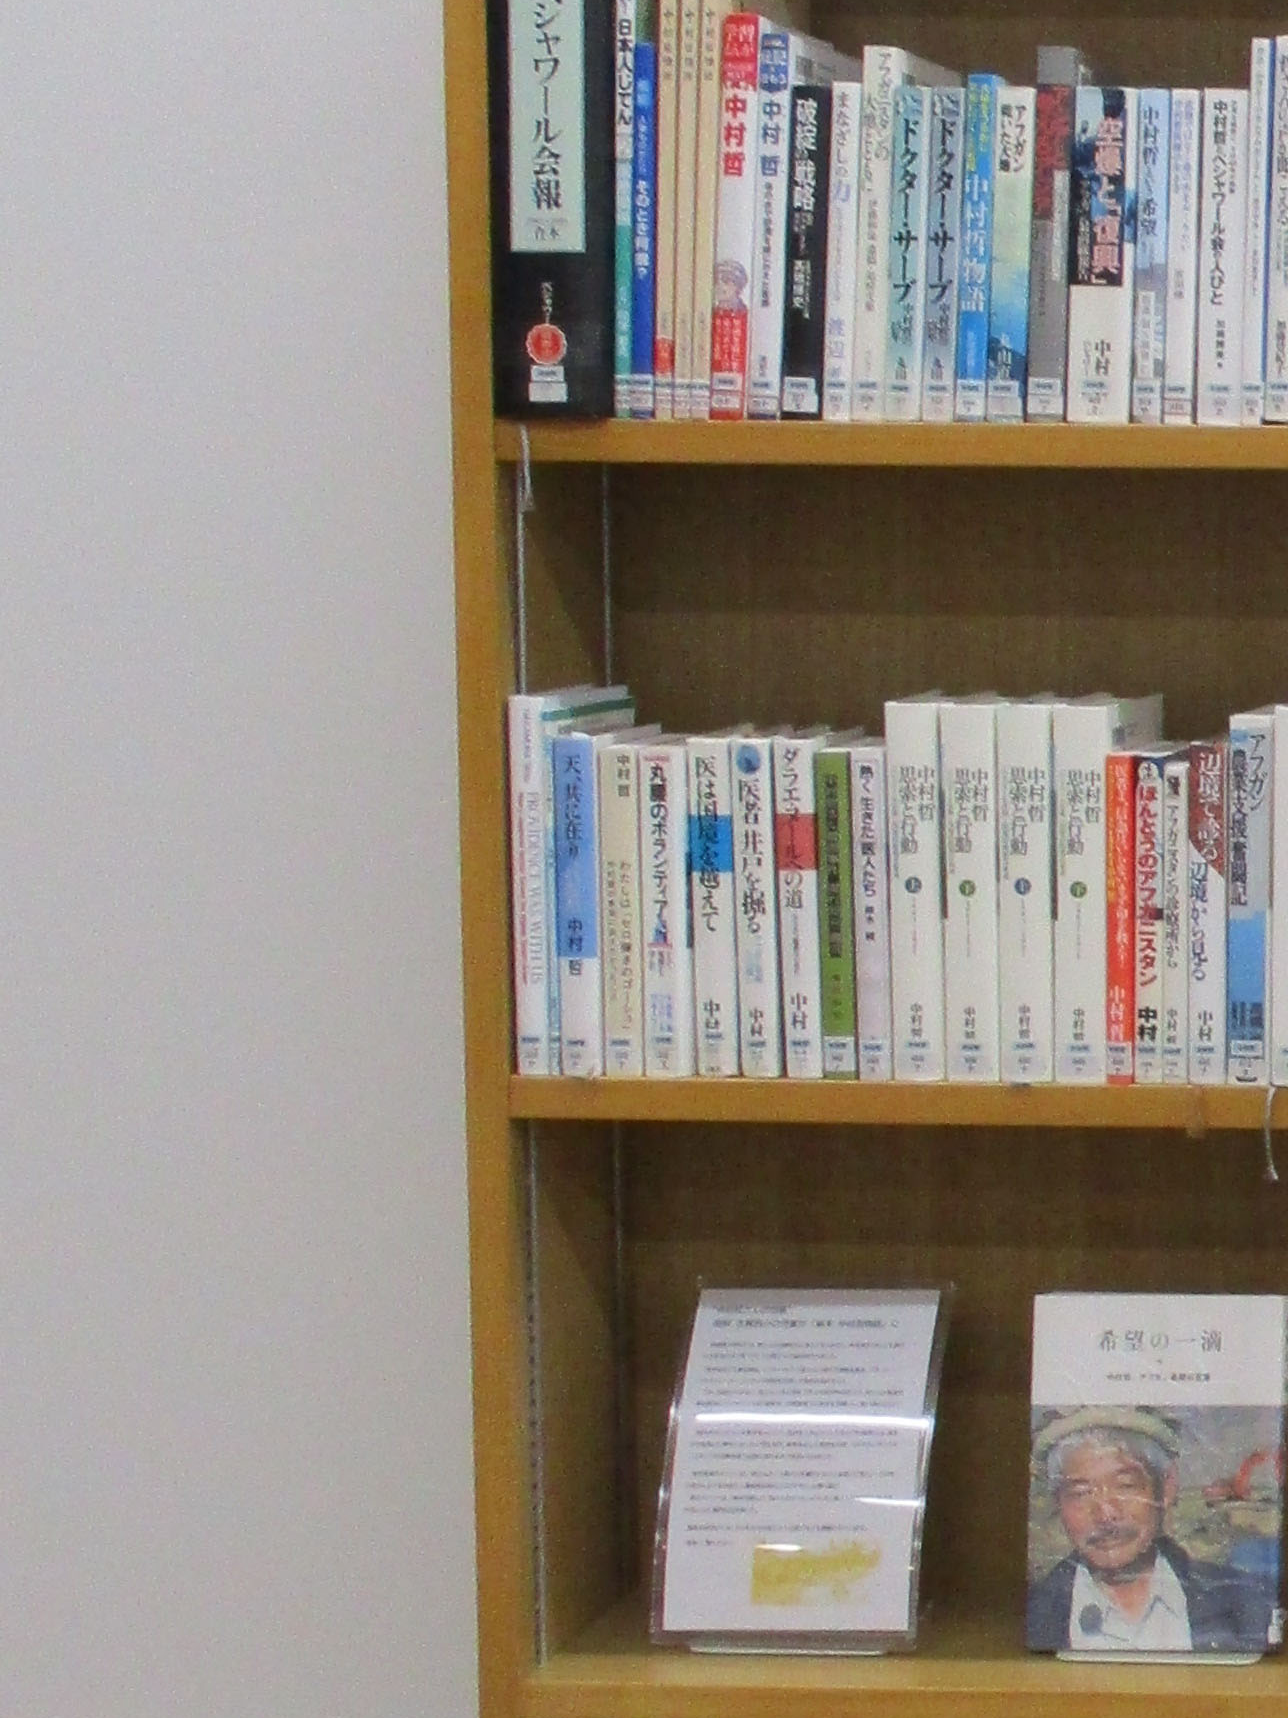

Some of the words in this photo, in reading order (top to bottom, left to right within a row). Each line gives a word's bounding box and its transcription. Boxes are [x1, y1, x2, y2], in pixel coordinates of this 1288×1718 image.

[893, 119, 919, 302] ドクター・サーブ
[928, 119, 956, 303] ドクター・サーブ
